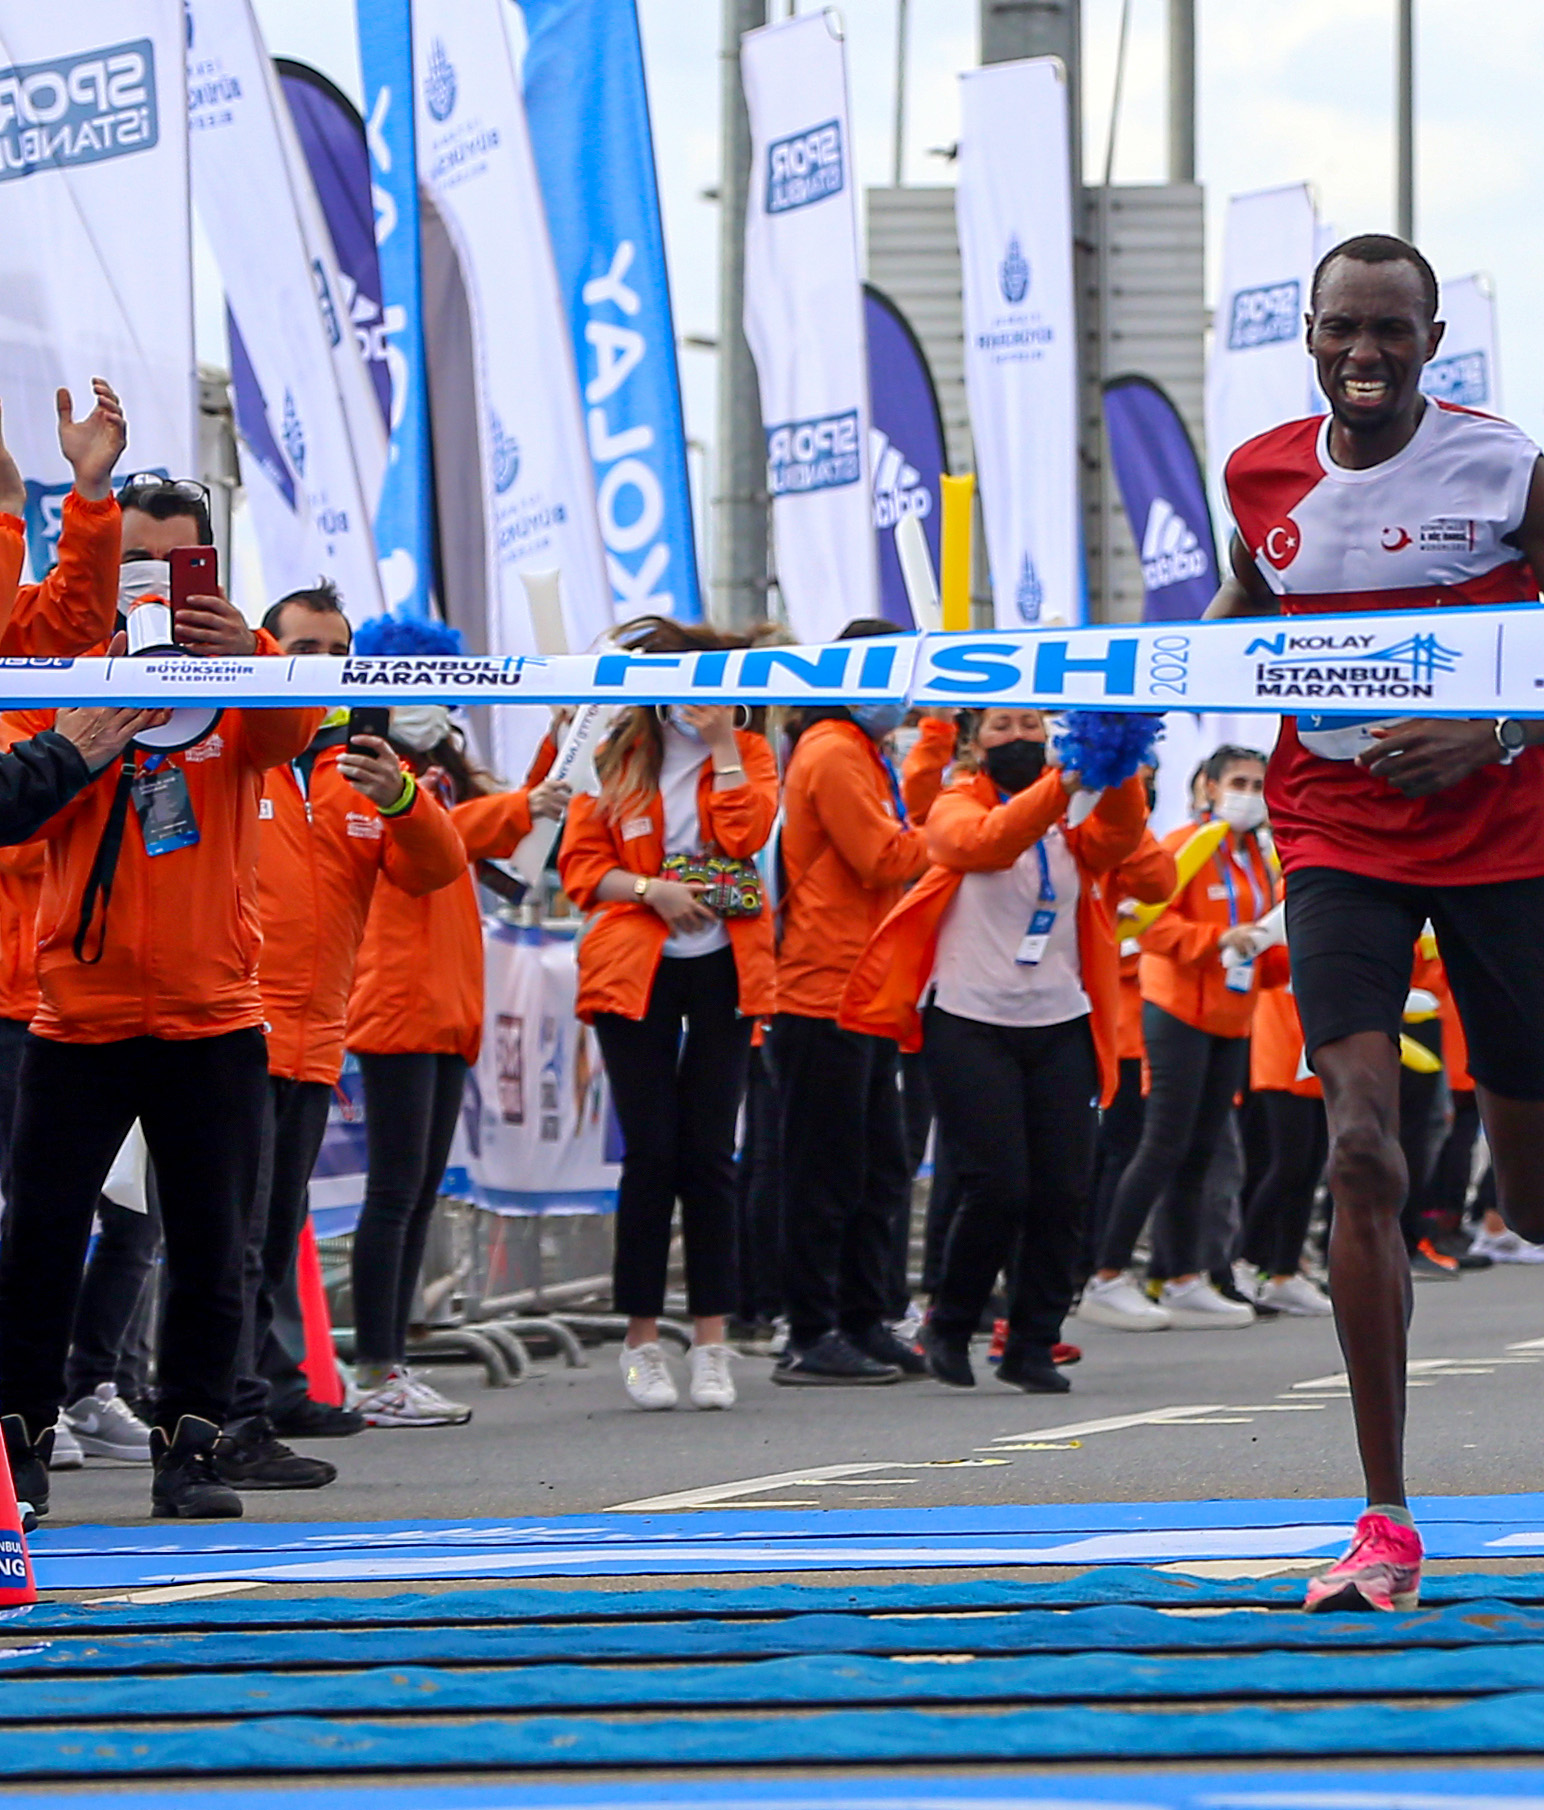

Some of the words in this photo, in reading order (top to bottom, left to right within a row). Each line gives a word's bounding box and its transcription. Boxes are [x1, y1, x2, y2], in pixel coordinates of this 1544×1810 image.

[1289, 634, 1377, 651] KOLAY
[145, 663, 255, 675] BÜYÜKŞEHİR
[592, 638, 1140, 697] FINISH
[1149, 635, 1190, 697] 2020
[340, 671, 522, 686] MARATONU
[1255, 683, 1435, 698] MARATHON
